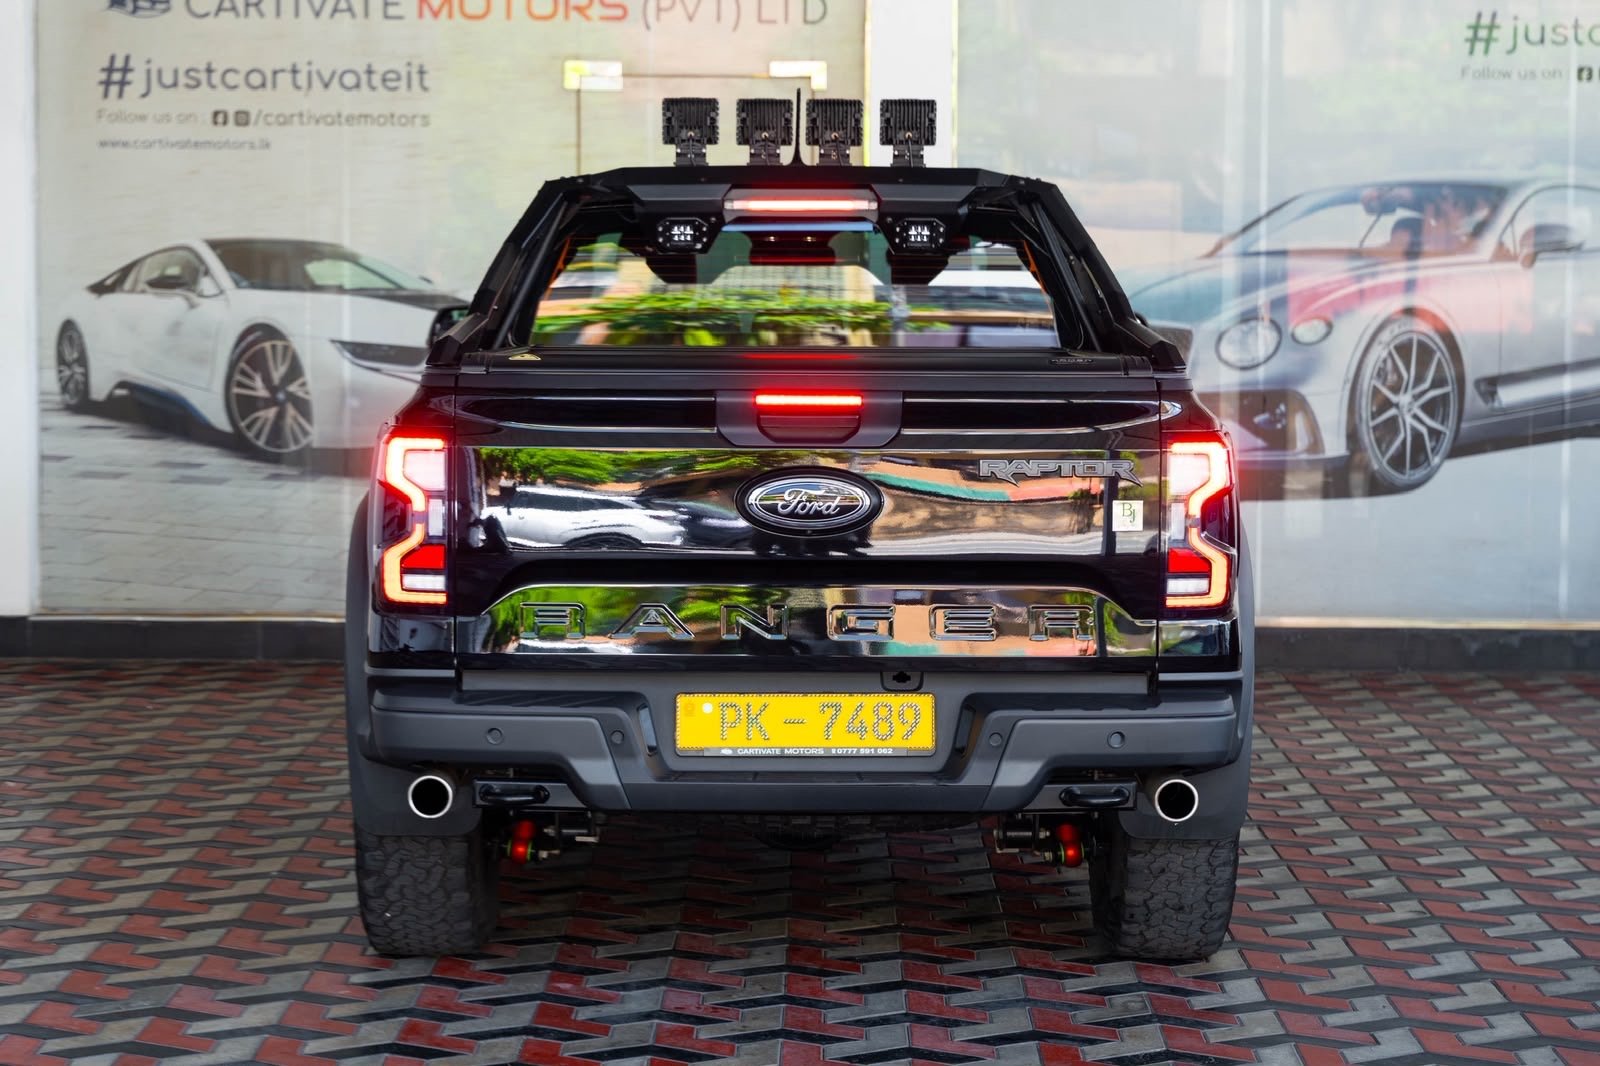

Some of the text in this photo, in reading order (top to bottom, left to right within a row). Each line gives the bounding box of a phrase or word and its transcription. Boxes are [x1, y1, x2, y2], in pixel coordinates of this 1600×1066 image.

[185, 0, 405, 20] CARTIVATE
[417, 0, 628, 20] MOTORS
[757, 0, 828, 25] LTD
[979, 459, 1144, 487] RAPTOR
[777, 488, 841, 515] Ford
[520, 601, 1096, 642] RANGER
[718, 701, 770, 741] PK
[819, 701, 922, 741] 7489
